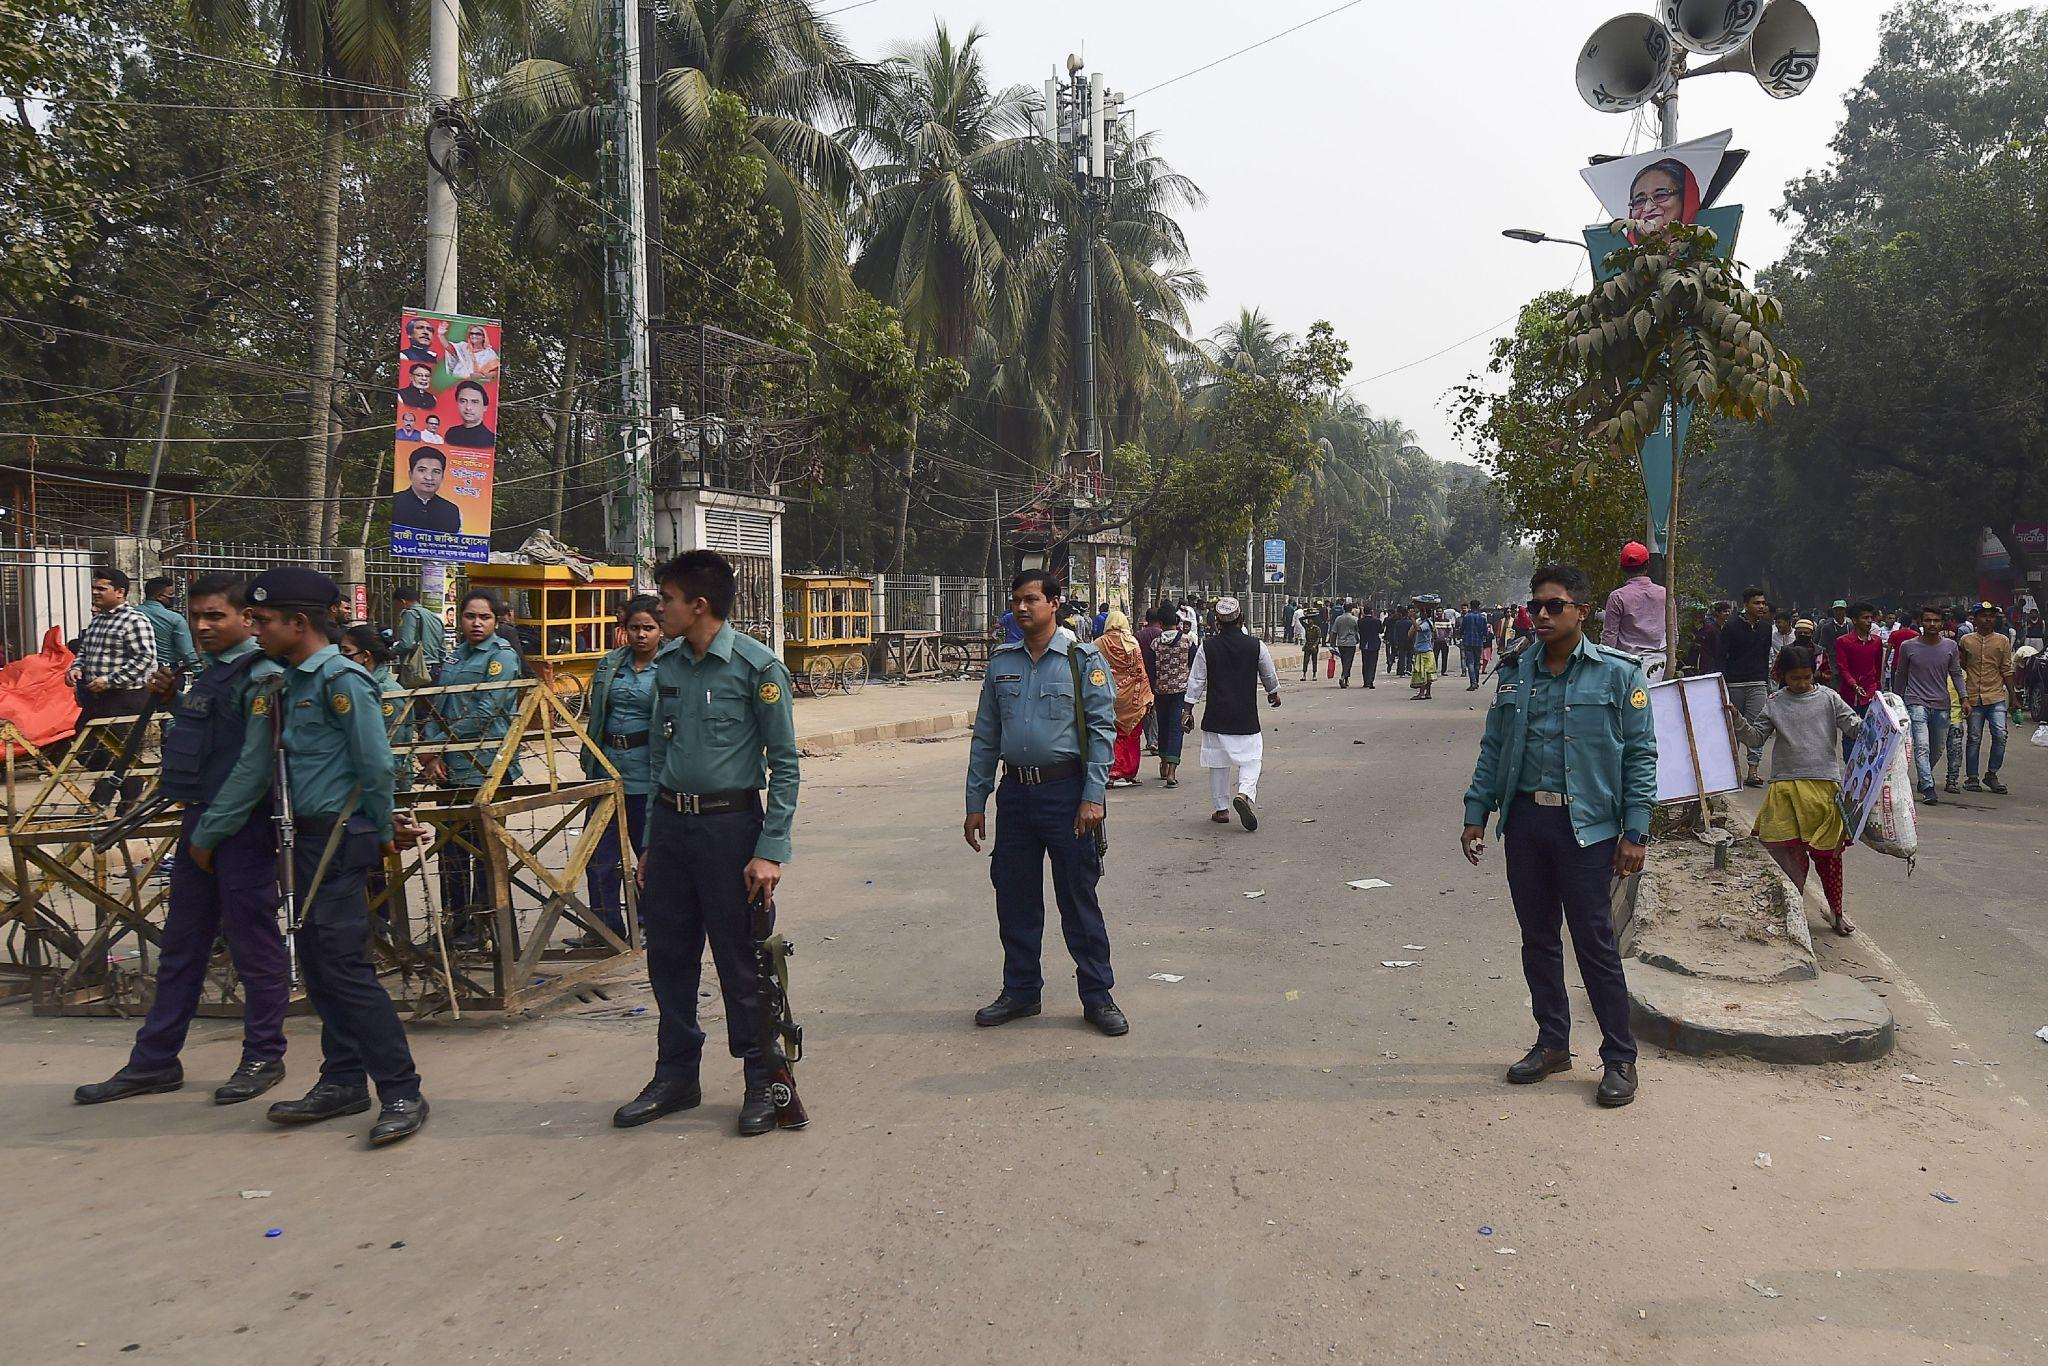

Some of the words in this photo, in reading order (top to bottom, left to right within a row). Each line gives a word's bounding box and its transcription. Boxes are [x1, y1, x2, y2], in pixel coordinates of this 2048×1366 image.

[393, 530, 412, 540] হাজী
[415, 533, 432, 542] মোঃ
[434, 533, 459, 543] জাকির
[461, 536, 488, 546] হোসেন
